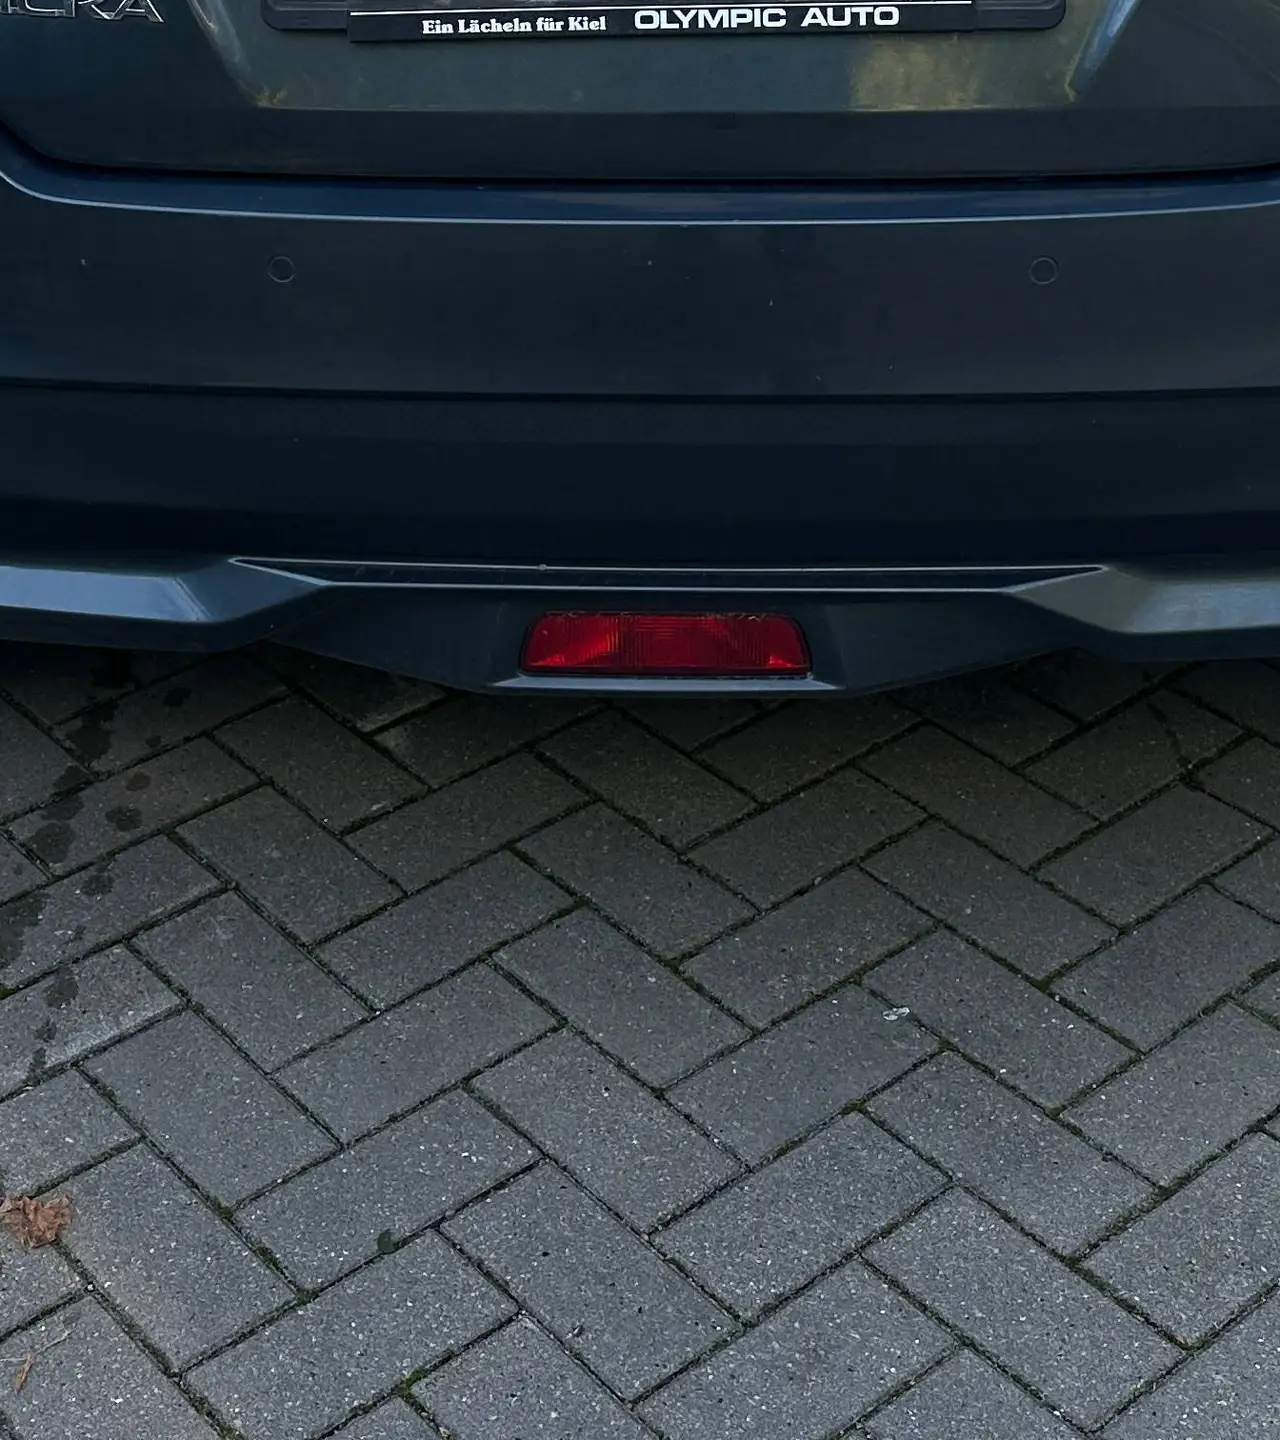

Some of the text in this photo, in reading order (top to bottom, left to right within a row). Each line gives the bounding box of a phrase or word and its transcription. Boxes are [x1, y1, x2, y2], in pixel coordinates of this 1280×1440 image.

[422, 5, 901, 35] Ein Lächeln für Kiel OLYMPIC AUTO
